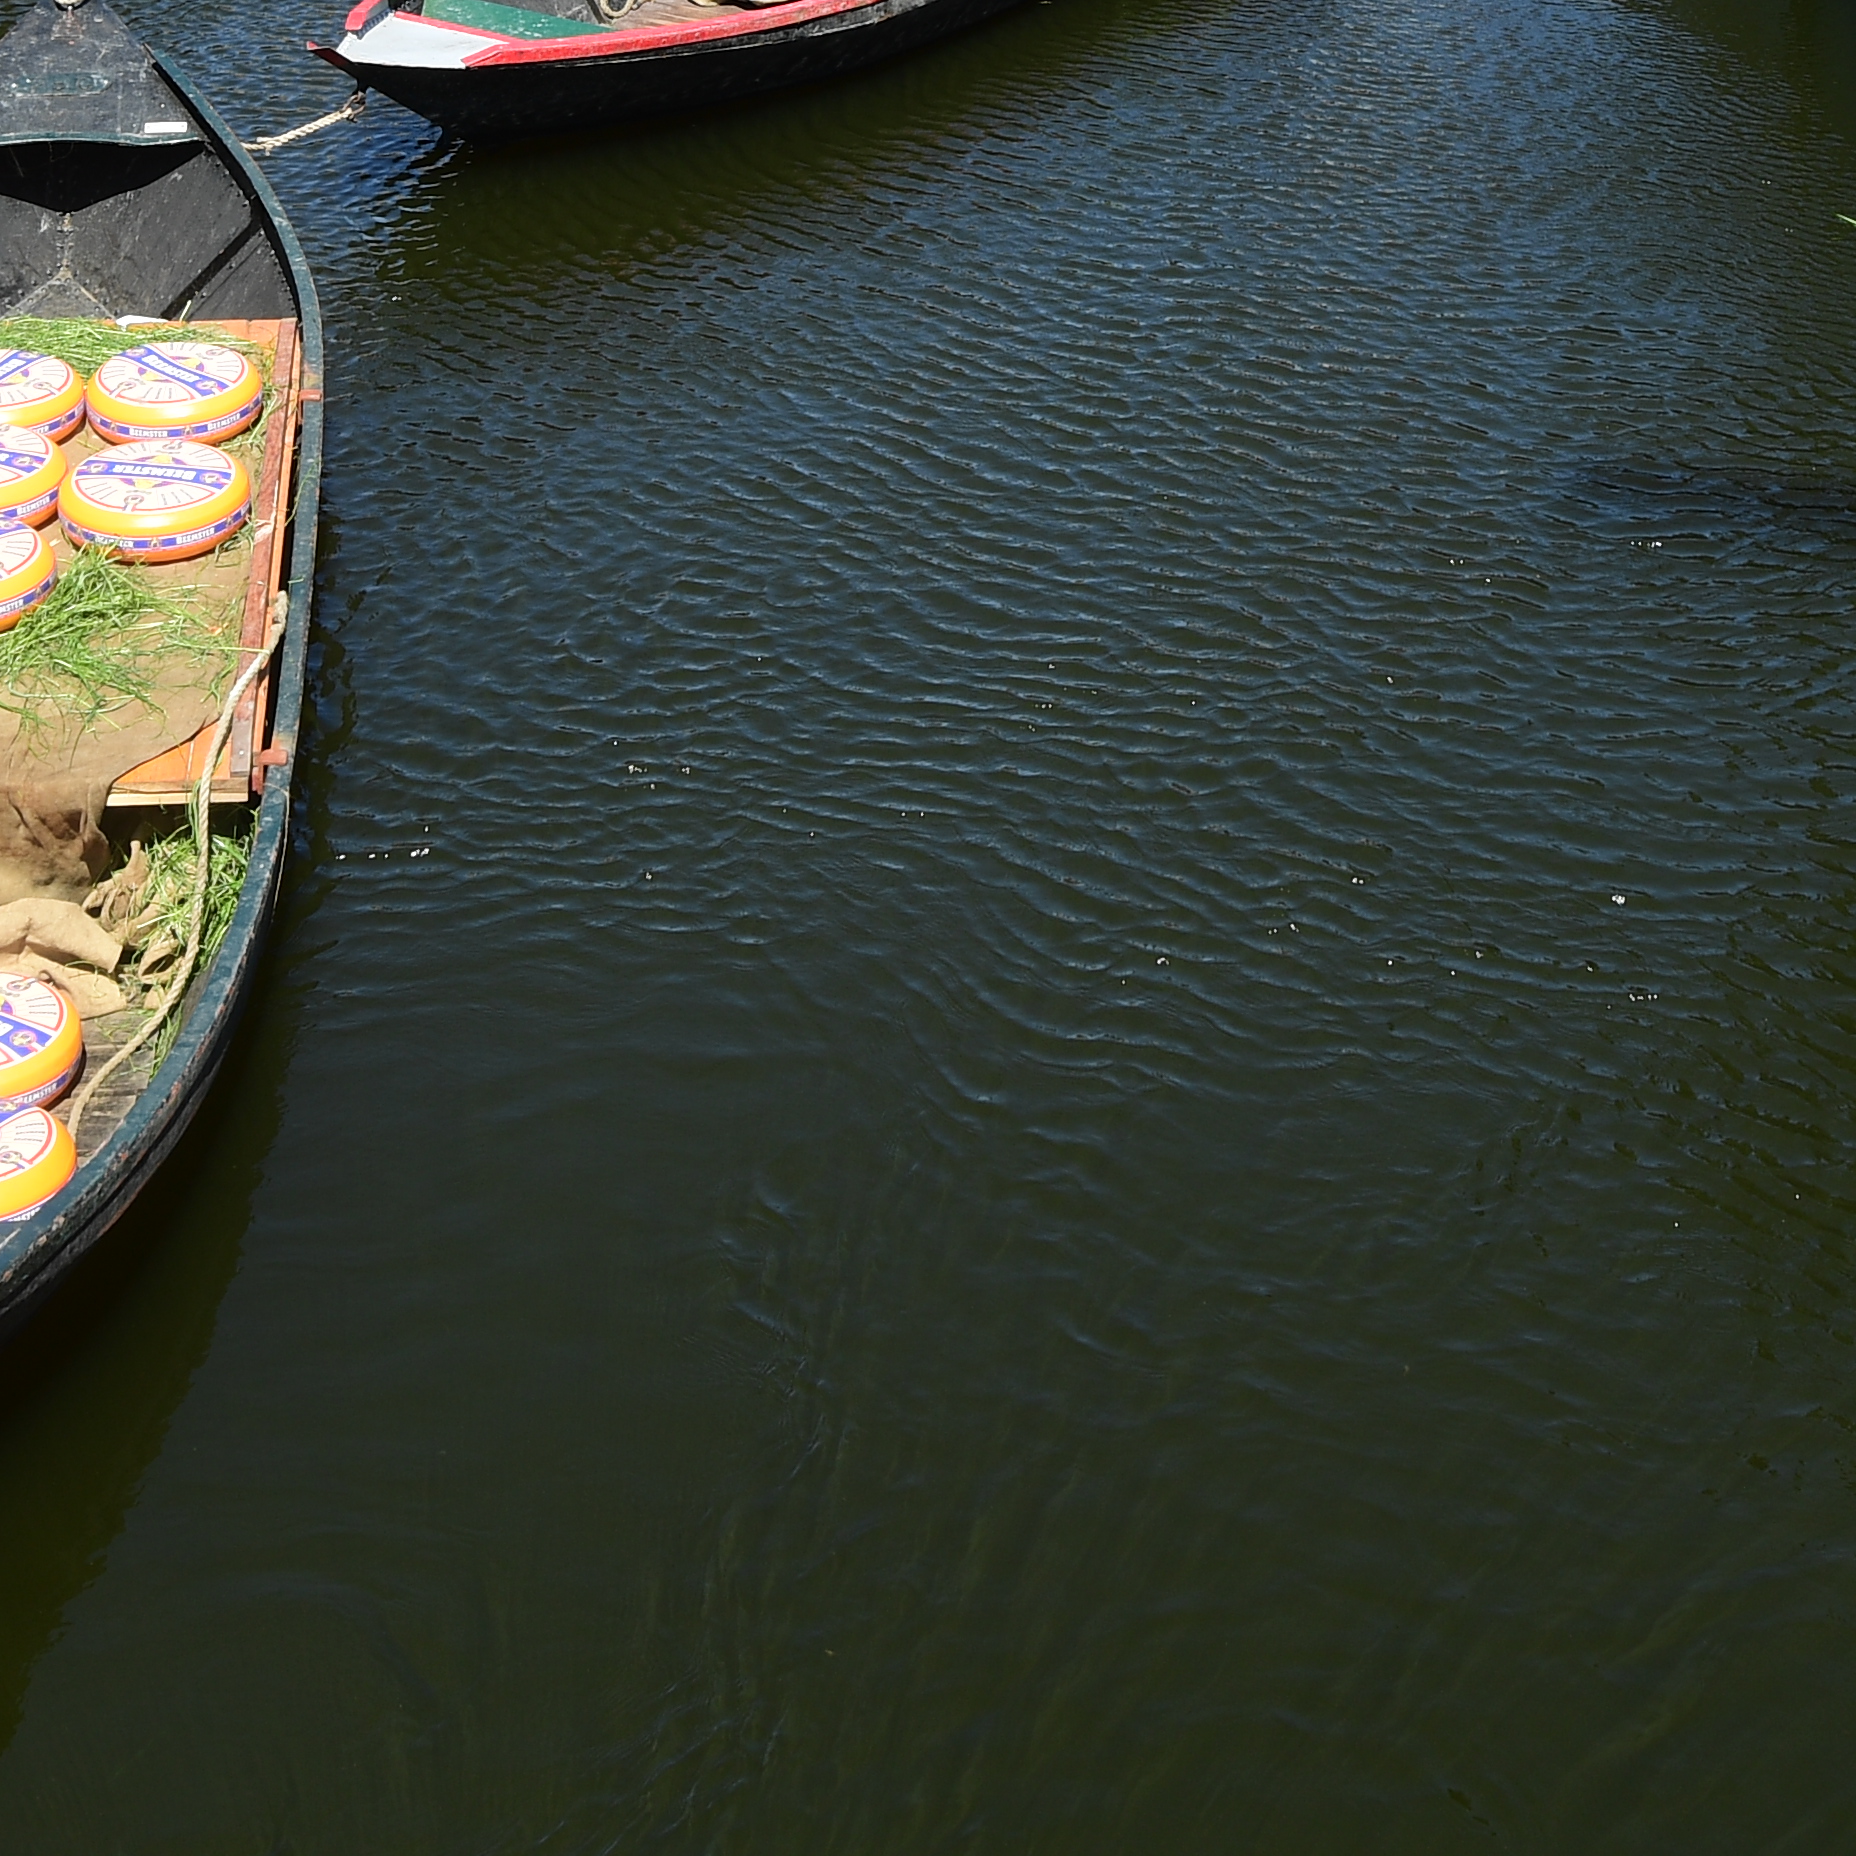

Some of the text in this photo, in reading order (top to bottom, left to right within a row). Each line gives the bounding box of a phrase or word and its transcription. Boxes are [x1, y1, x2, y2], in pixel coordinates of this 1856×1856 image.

[142, 354, 201, 383] BEEMSTER
[207, 412, 242, 431] BEEMSTER
[129, 427, 169, 438] BEEMSTER
[112, 464, 197, 481] BEEMSTER
[16, 495, 51, 515] BEEMSTER
[175, 527, 216, 545] BEEMSTER
